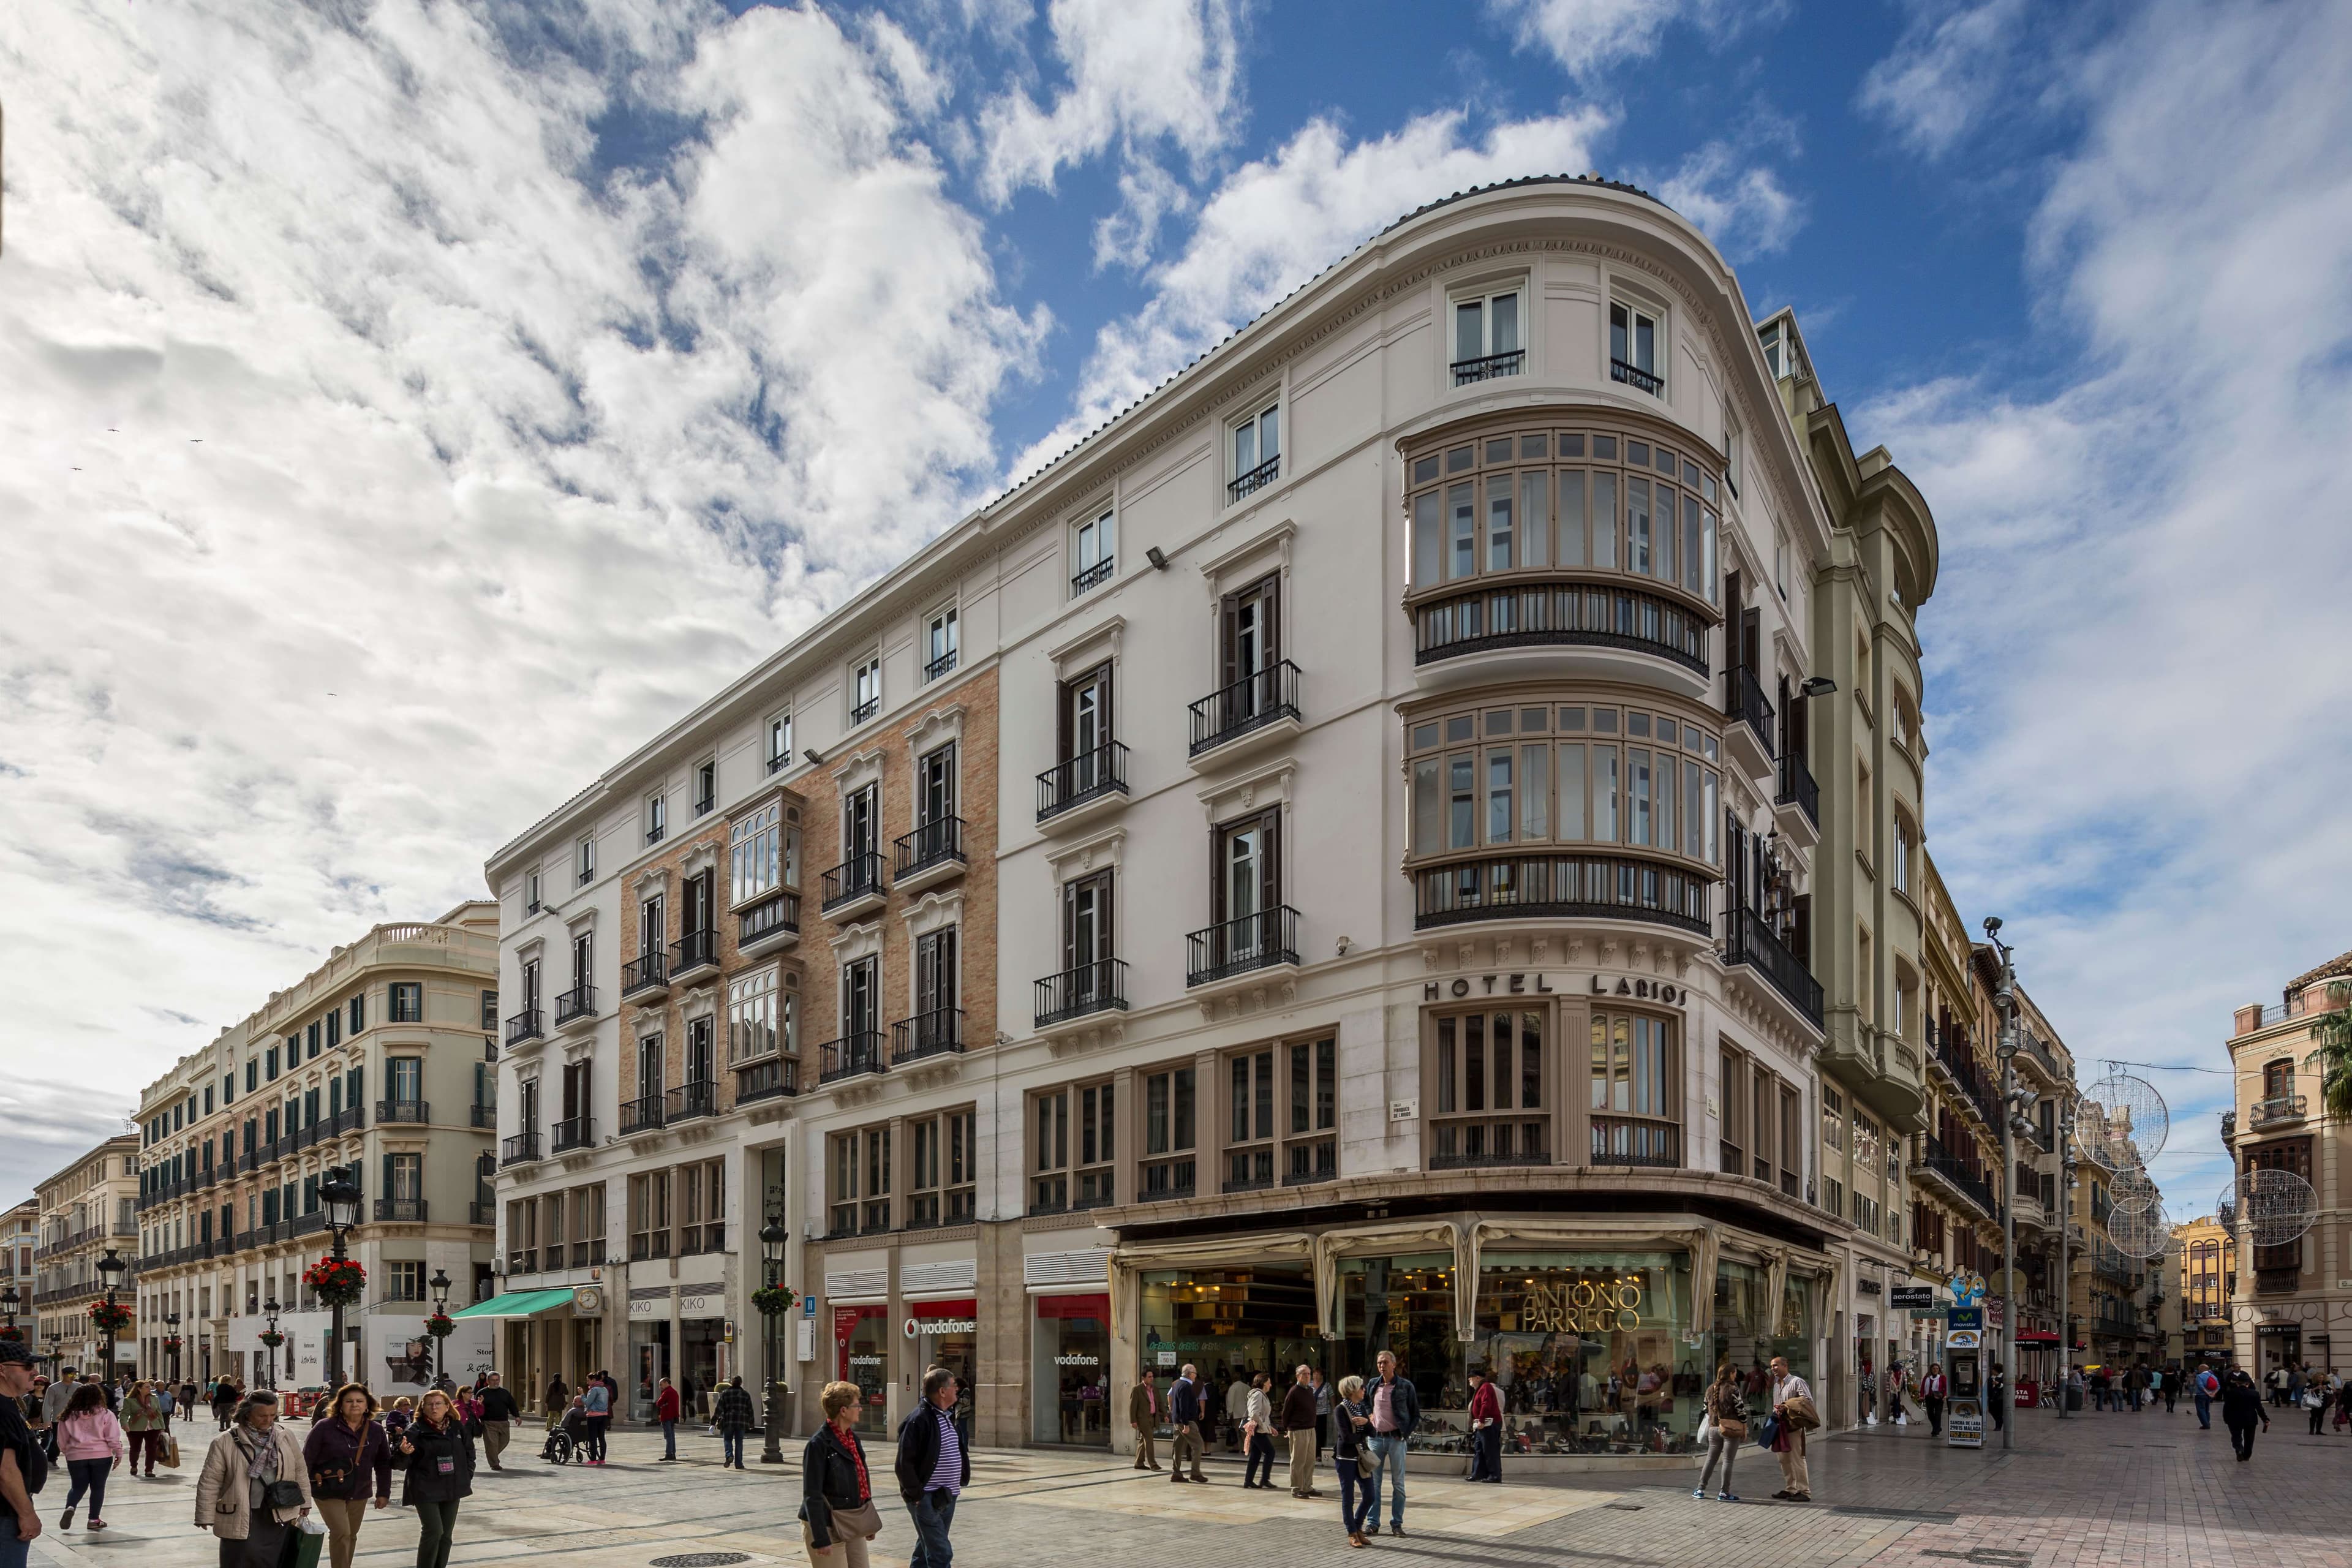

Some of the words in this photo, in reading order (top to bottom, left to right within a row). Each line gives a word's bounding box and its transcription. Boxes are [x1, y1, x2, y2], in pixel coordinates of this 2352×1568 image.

[1424, 974, 1553, 1001] HOTEL
[1592, 974, 1687, 1006] LARIOS
[1523, 1284, 1641, 1308] ANTONIO
[629, 1301, 651, 1313] KIKO
[680, 1297, 705, 1310] KIKO
[919, 1318, 974, 1334] vodafone
[1523, 1307, 1640, 1333] PARRIEGO
[850, 1355, 881, 1365] vodafone
[1054, 1354, 1098, 1365] vodafone
[467, 1363, 475, 1372] &
